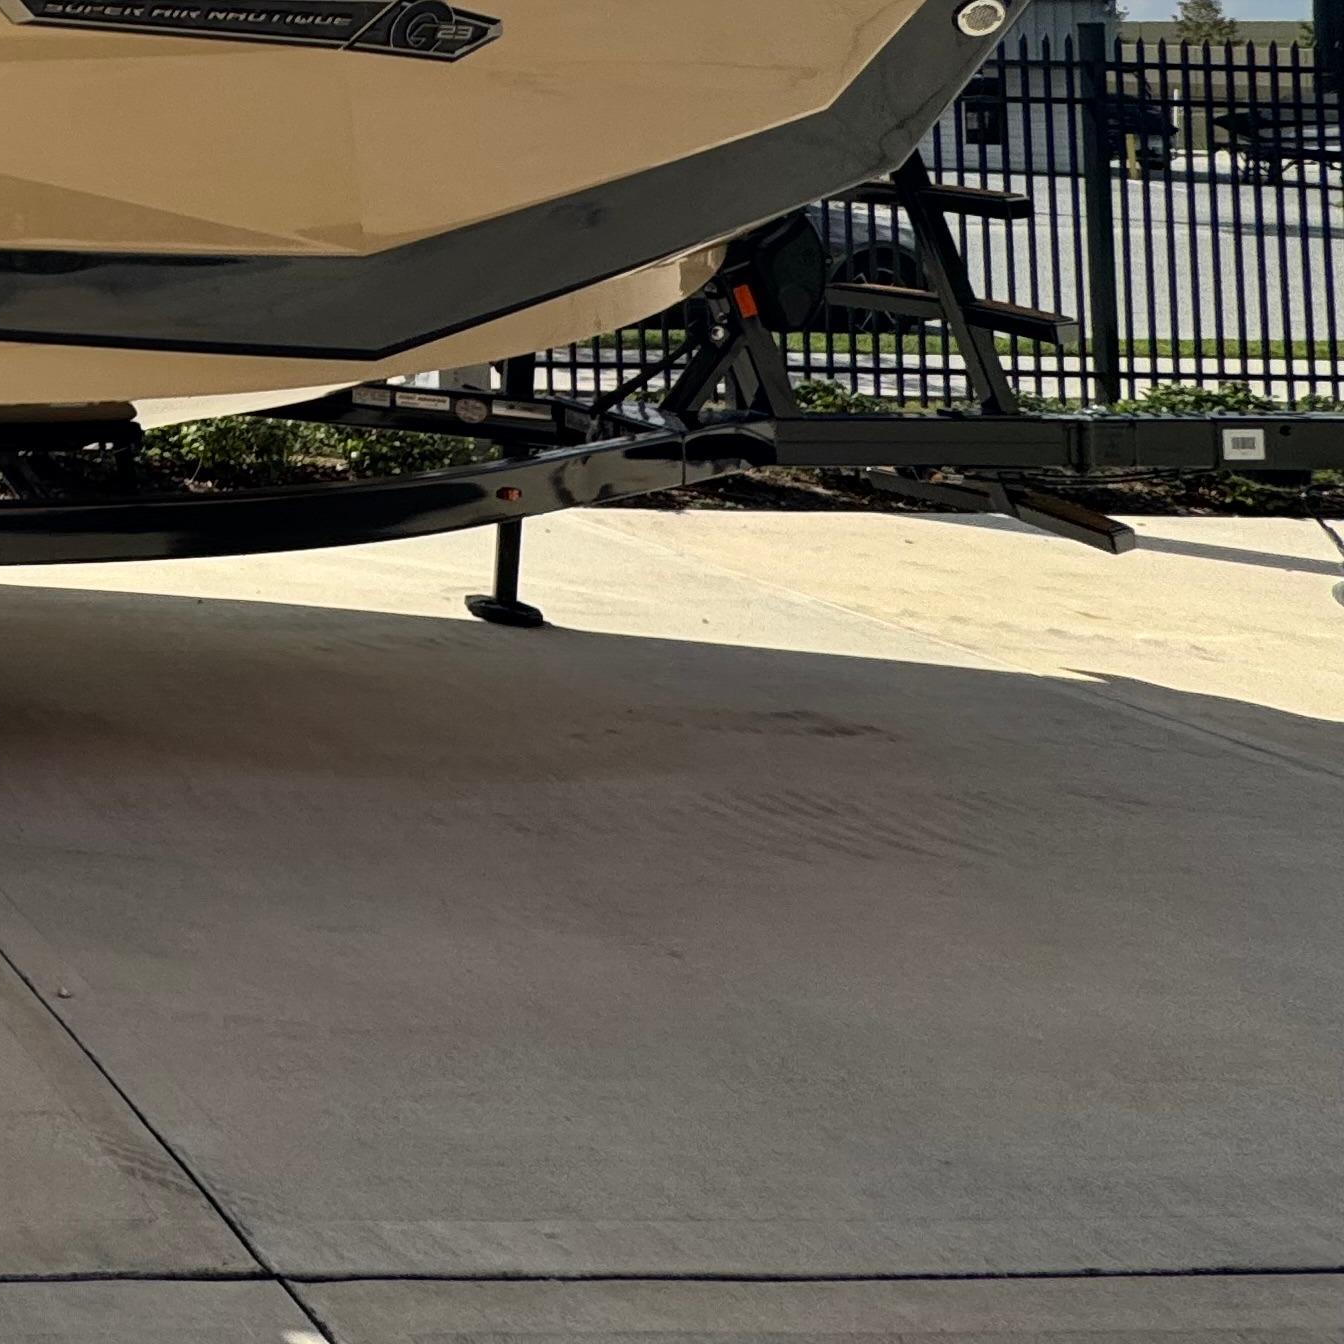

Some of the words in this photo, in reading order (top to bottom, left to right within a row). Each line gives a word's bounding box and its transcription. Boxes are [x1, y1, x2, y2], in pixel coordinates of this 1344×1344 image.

[44, 2, 146, 17] SUPER
[150, 5, 200, 20] AIR
[205, 7, 354, 27] NAUTIQUE
